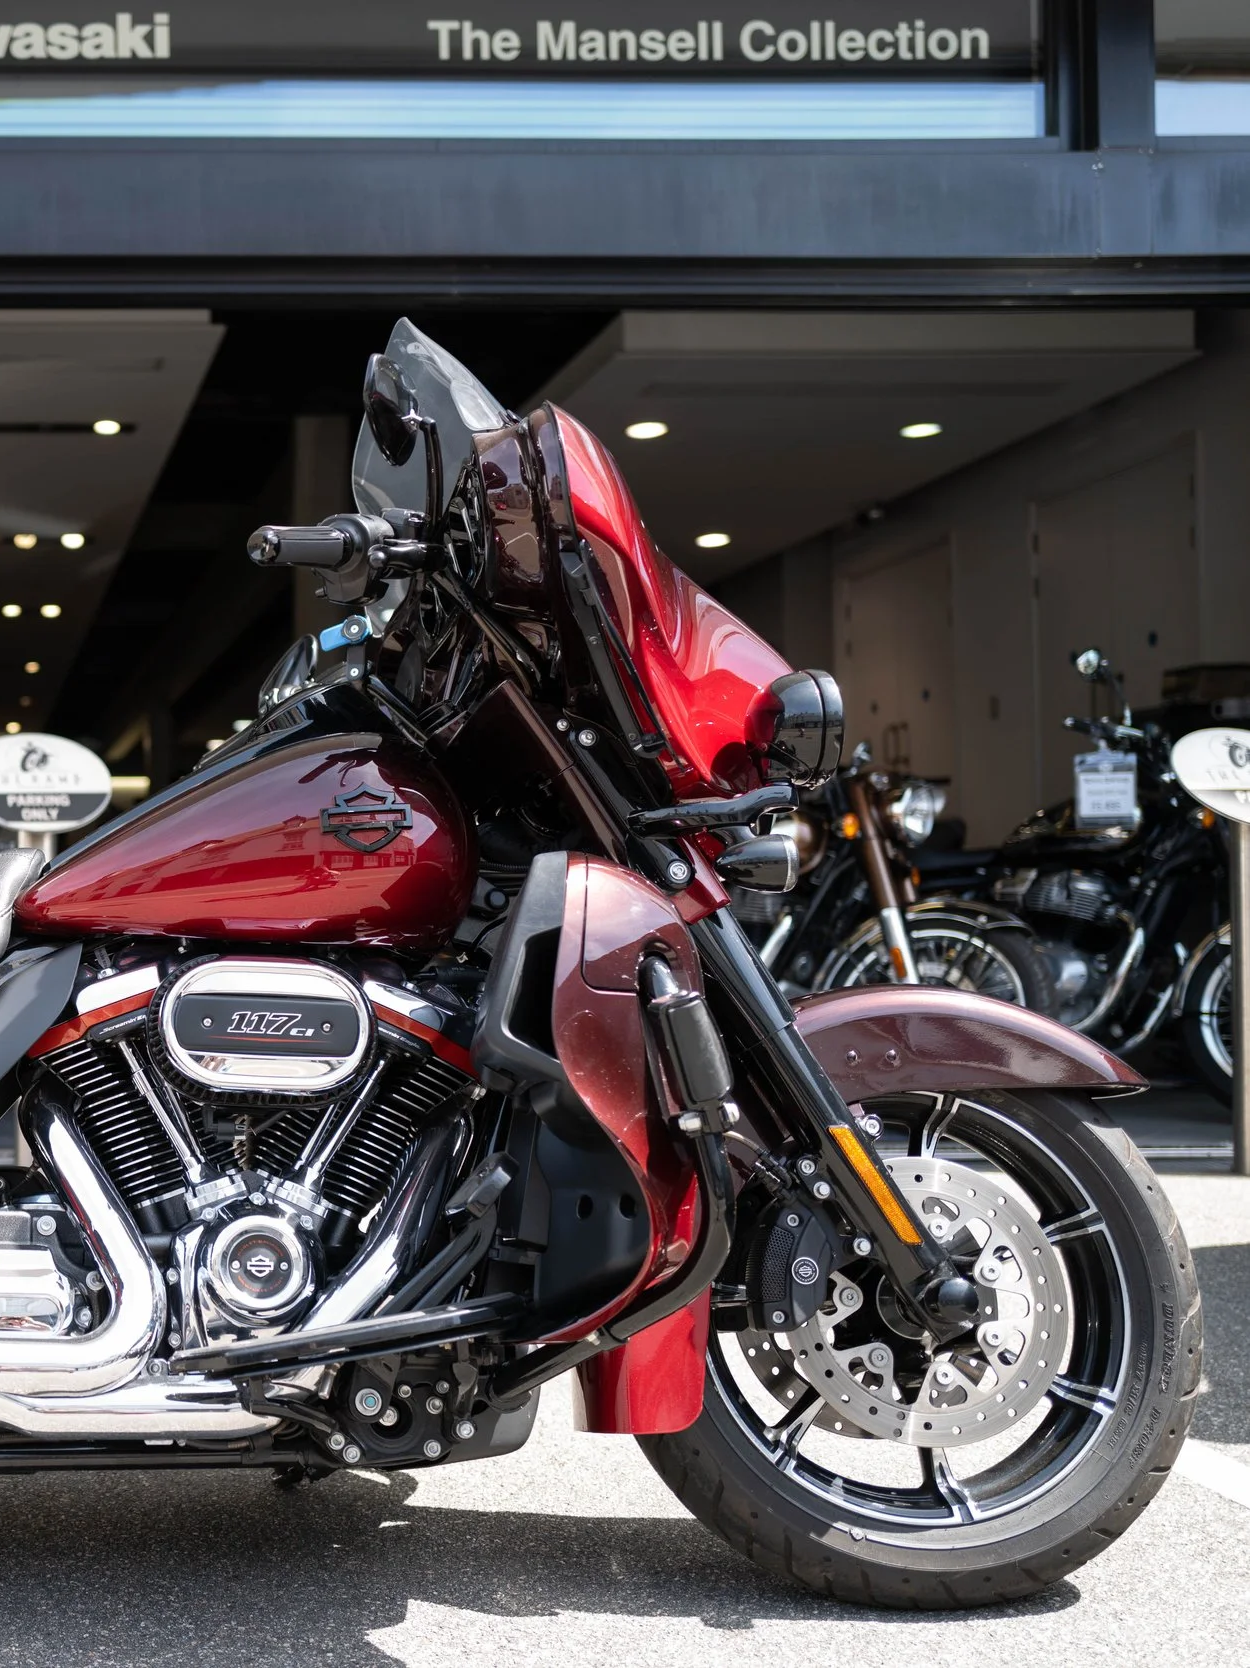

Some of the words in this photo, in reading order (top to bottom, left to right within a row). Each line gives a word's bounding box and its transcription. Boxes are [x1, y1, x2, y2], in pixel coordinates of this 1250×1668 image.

[427, 20, 521, 61] The
[536, 20, 723, 61] Mansell
[739, 19, 989, 62] Collection
[6, 794, 71, 808] PARKING
[20, 807, 60, 821] ONLY
[1160, 1302, 1176, 1394] DUNLOP
